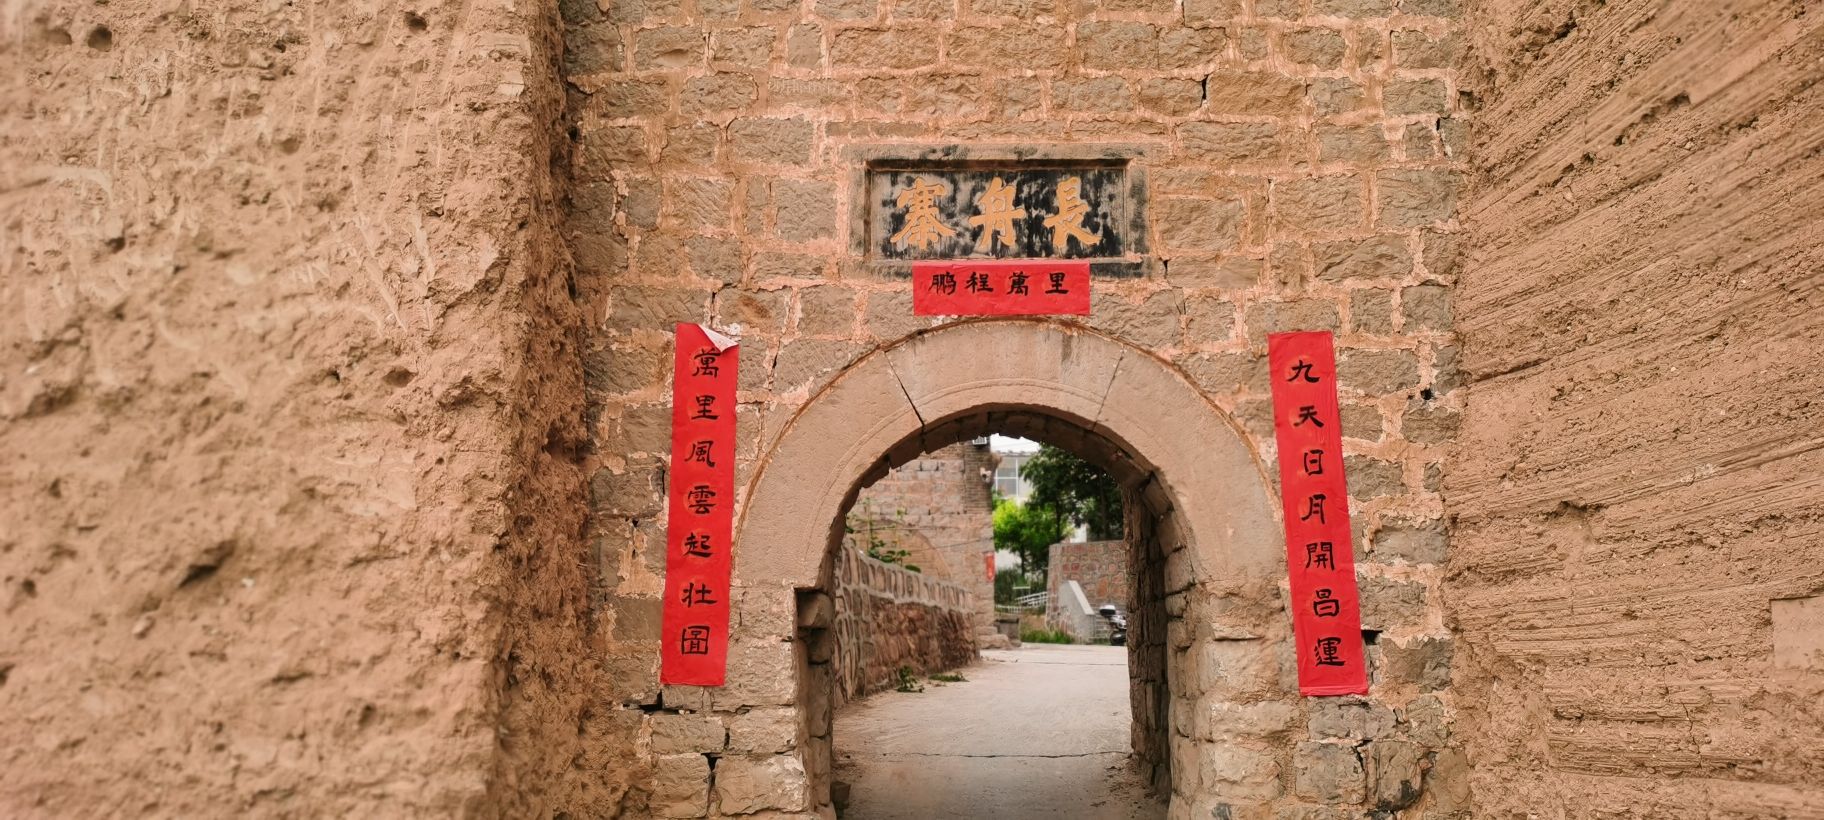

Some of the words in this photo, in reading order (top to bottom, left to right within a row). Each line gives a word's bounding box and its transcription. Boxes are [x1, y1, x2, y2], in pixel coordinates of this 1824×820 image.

[1286, 359, 1346, 667] 九天日月開昌運
